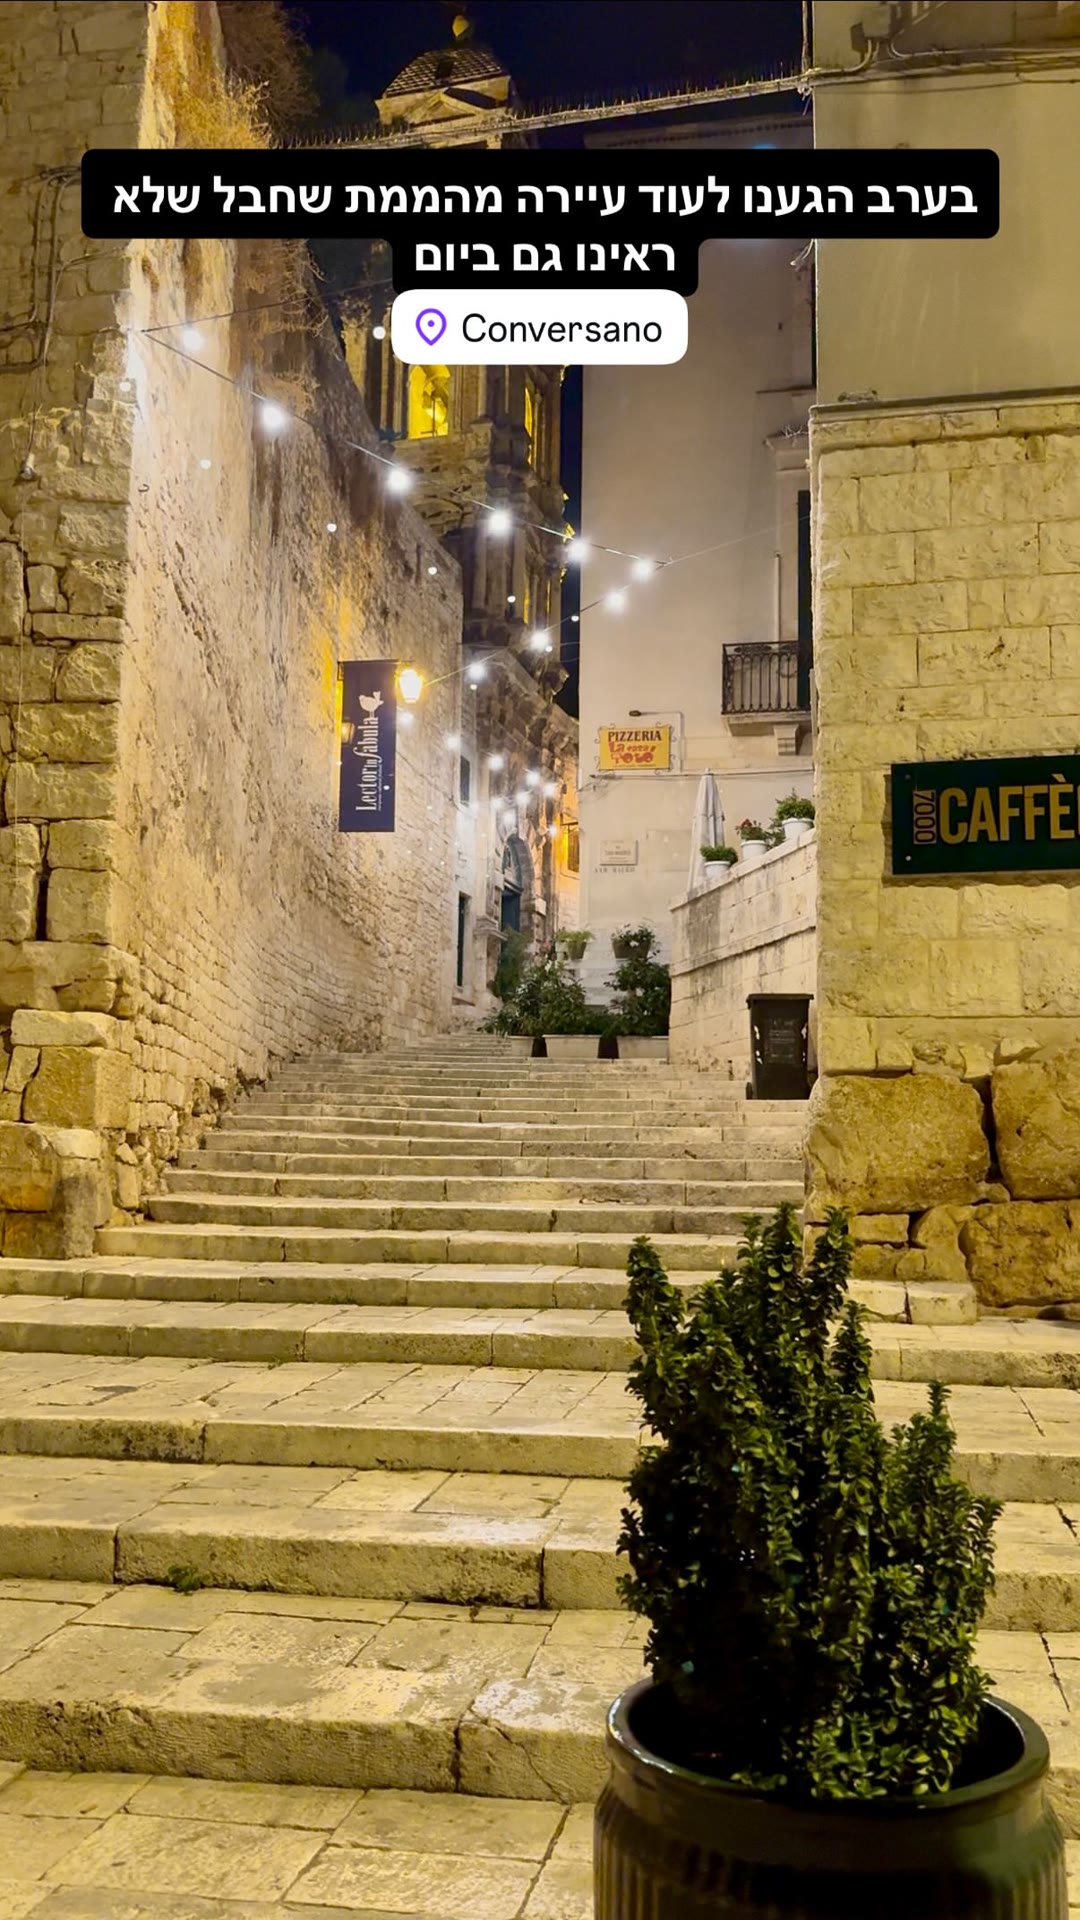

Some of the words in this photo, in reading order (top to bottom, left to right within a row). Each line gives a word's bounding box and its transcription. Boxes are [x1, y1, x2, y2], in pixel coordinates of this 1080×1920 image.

[608, 730, 662, 742] PIZZERIA
[913, 790, 937, 844] 7000
[939, 773, 1080, 845] CAFFÈ
